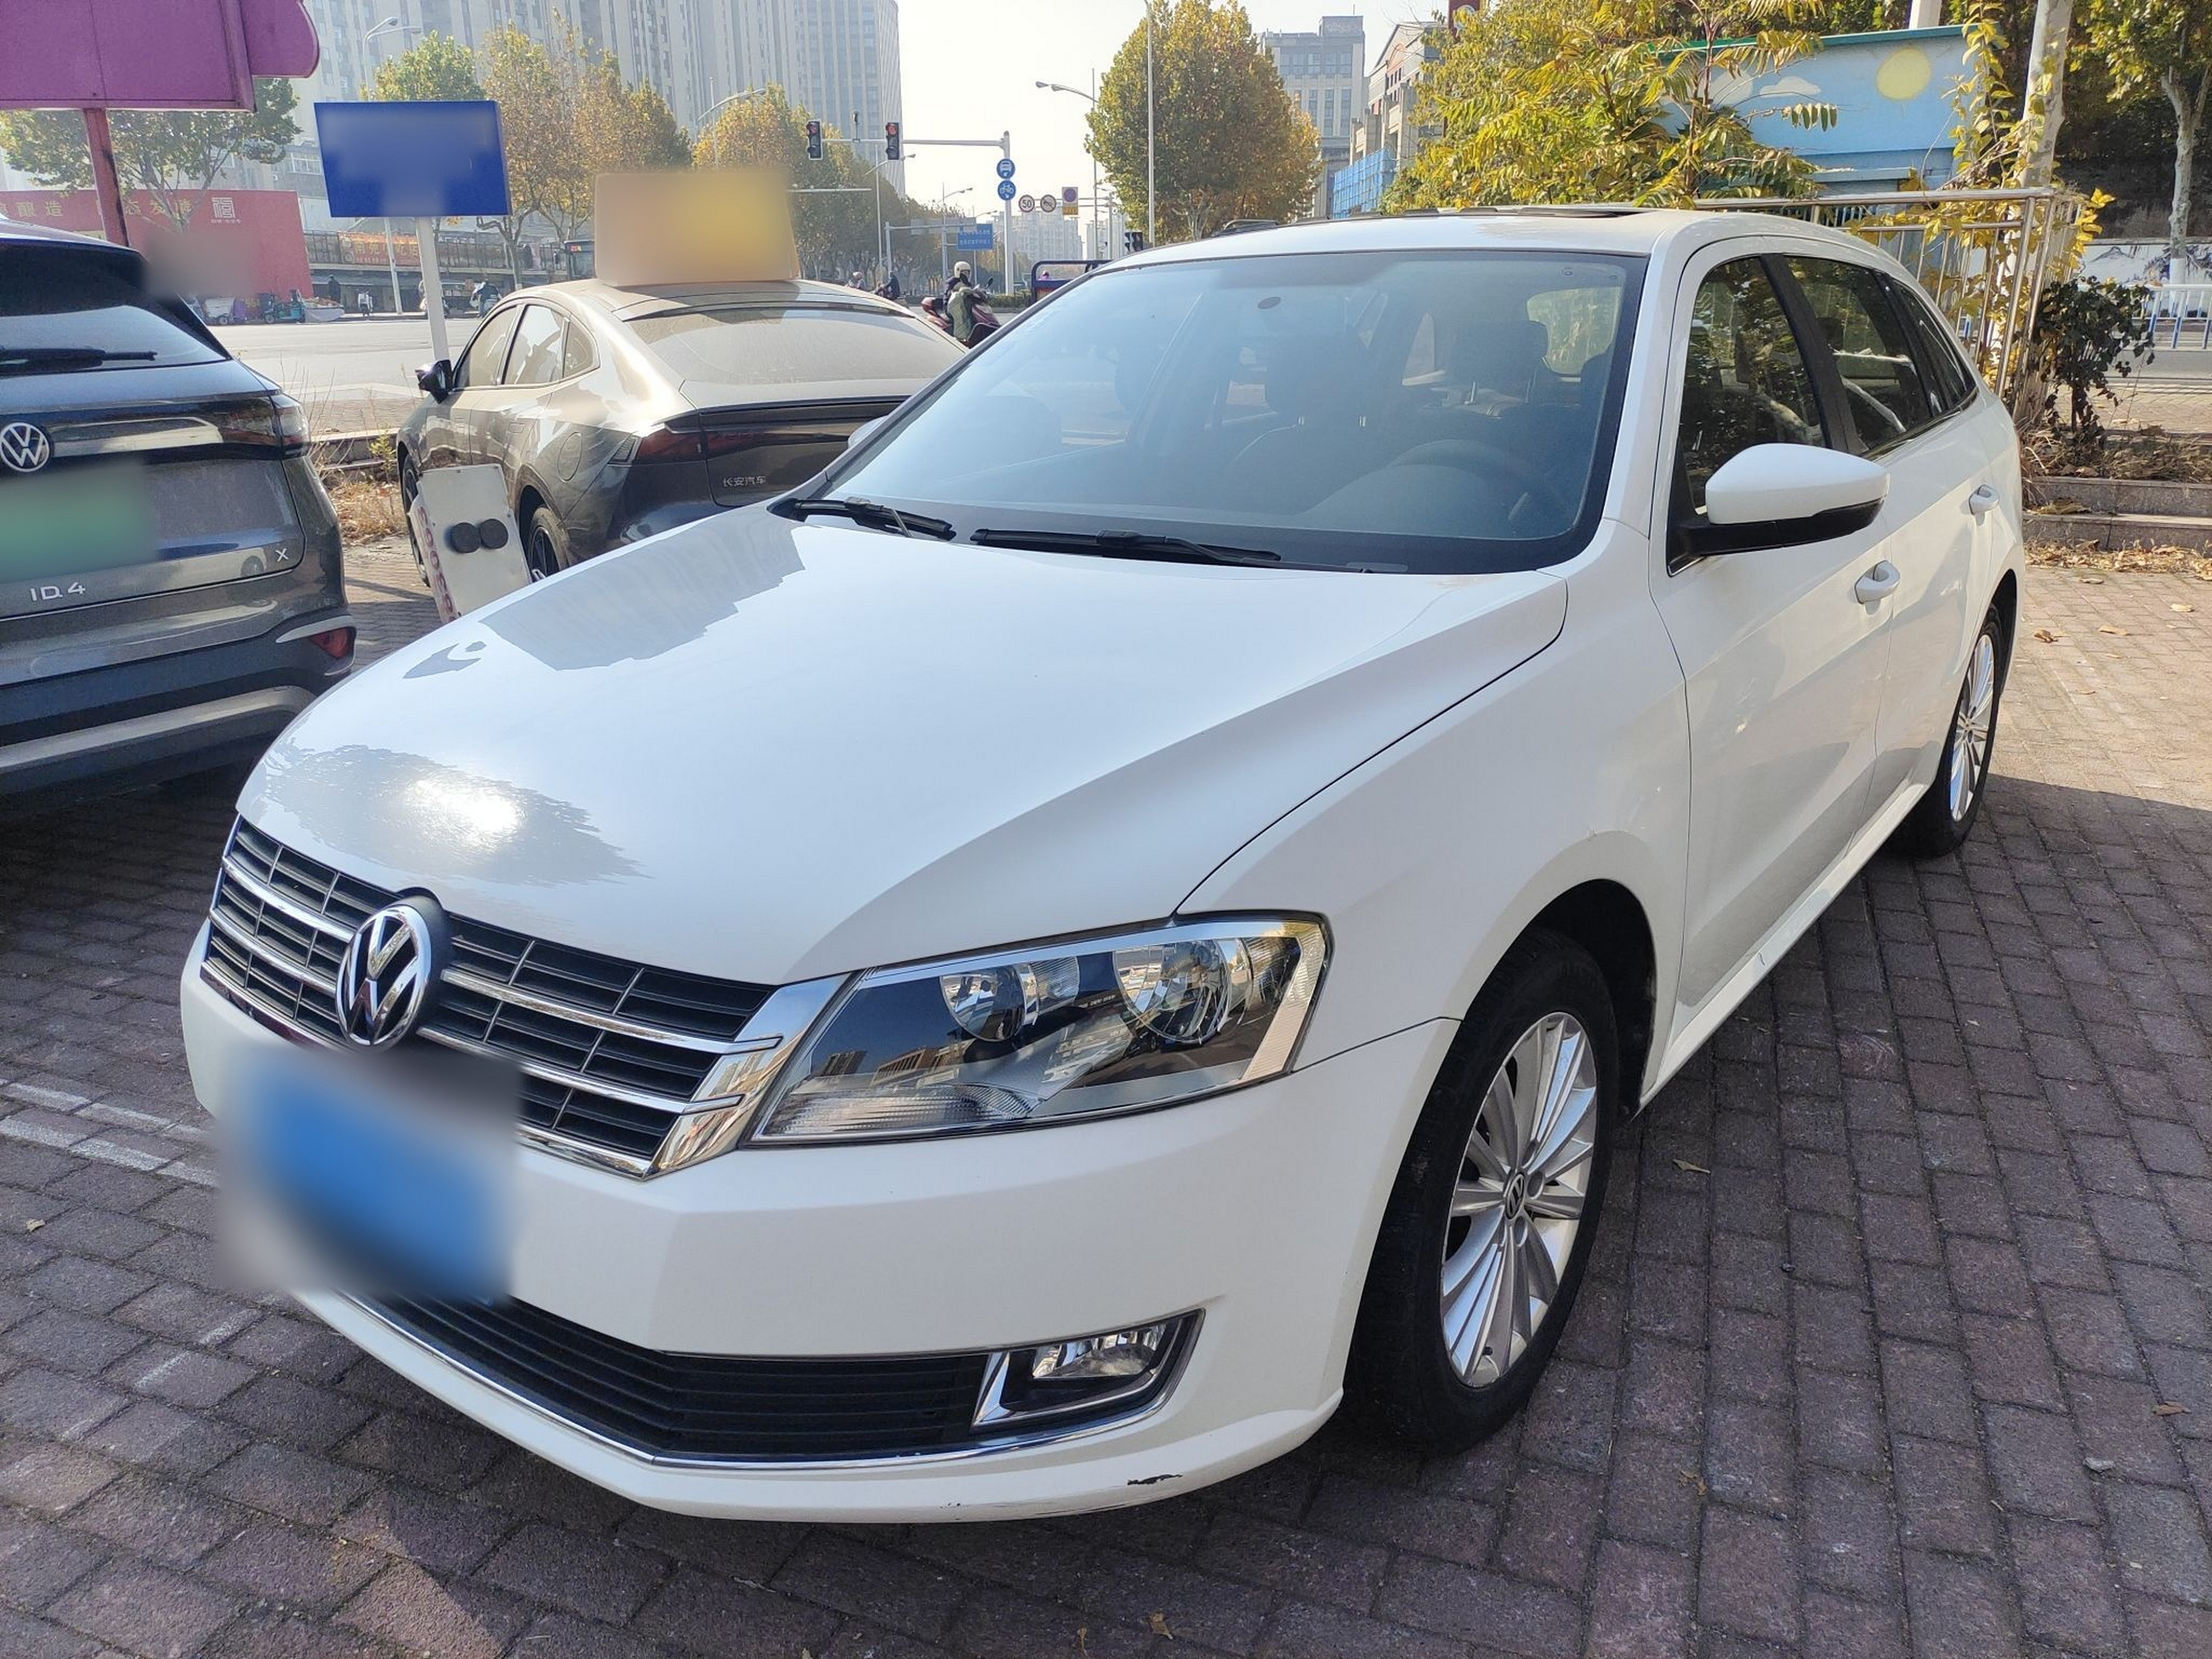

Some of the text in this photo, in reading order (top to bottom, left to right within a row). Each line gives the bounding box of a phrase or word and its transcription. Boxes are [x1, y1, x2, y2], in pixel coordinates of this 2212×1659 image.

[1022, 199, 1032, 208] 50
[723, 475, 766, 487] 长安汽车
[275, 548, 289, 563] X
